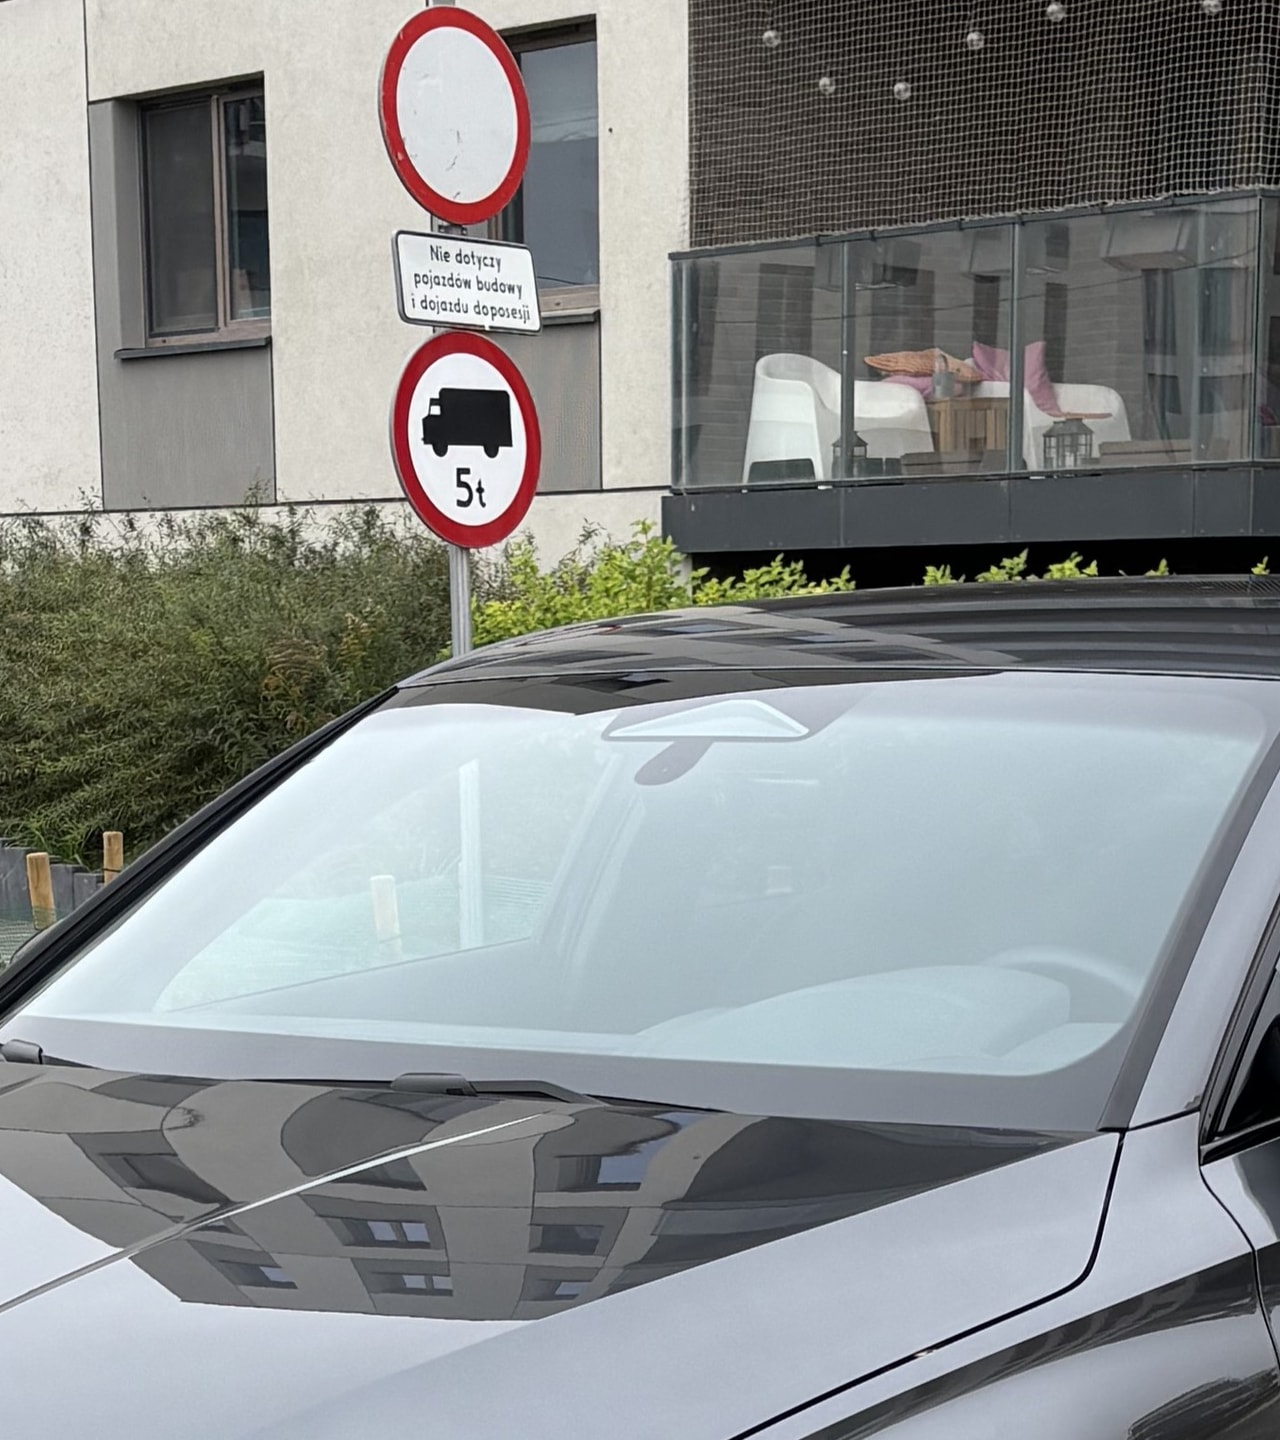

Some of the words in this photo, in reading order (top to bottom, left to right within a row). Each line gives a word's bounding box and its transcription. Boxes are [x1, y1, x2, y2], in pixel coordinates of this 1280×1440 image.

[429, 244, 451, 263] Nie
[455, 248, 502, 273] dotyczy
[413, 269, 472, 289] pojazdów
[475, 275, 523, 300] budowy
[410, 292, 416, 309] i
[420, 294, 469, 315] dojazdu
